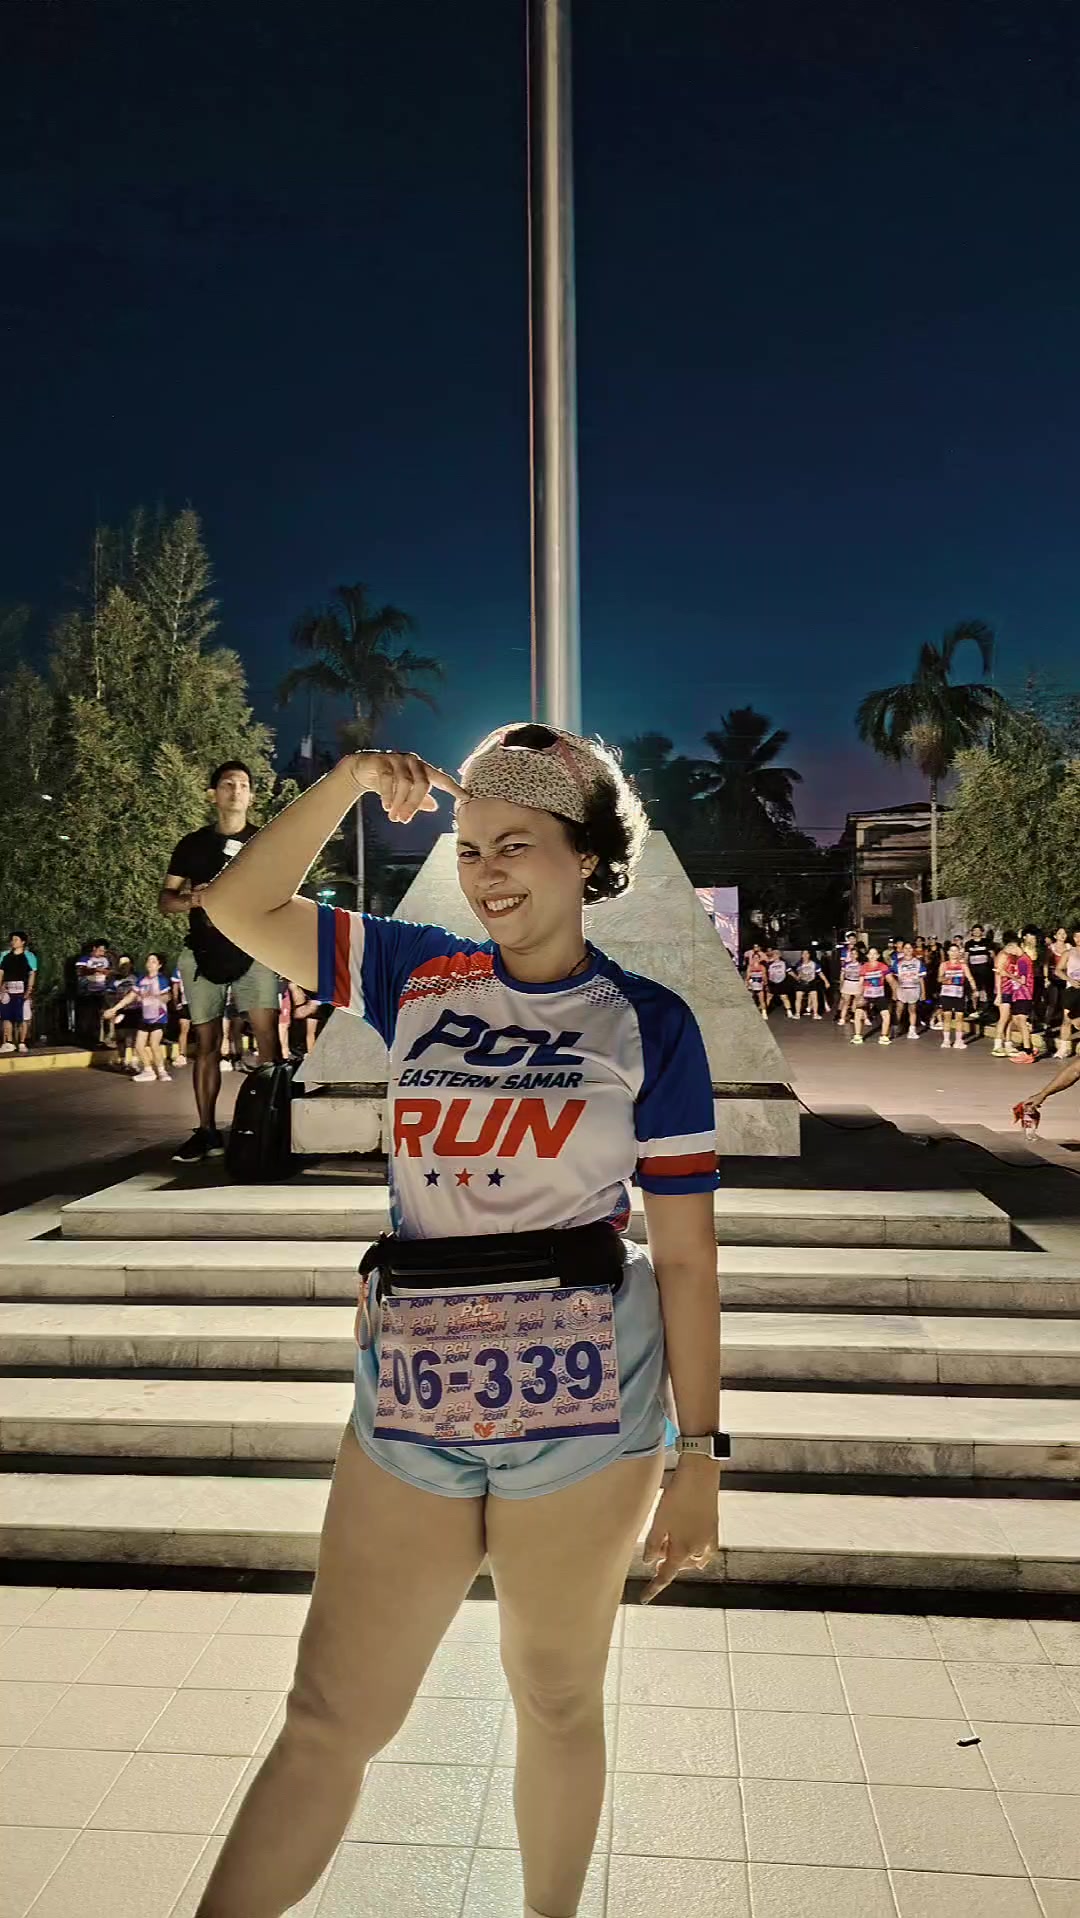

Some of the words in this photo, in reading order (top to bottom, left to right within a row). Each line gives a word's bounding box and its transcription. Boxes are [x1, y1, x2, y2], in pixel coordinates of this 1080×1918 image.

[402, 1008, 585, 1066] PCL
[398, 1068, 500, 1089] EASTERN
[501, 1072, 583, 1089] SAMAR
[393, 1098, 588, 1158] RUN
[461, 1303, 492, 1317] PCL
[393, 1341, 603, 1410] 06-339
[554, 1404, 580, 1416] RUN
